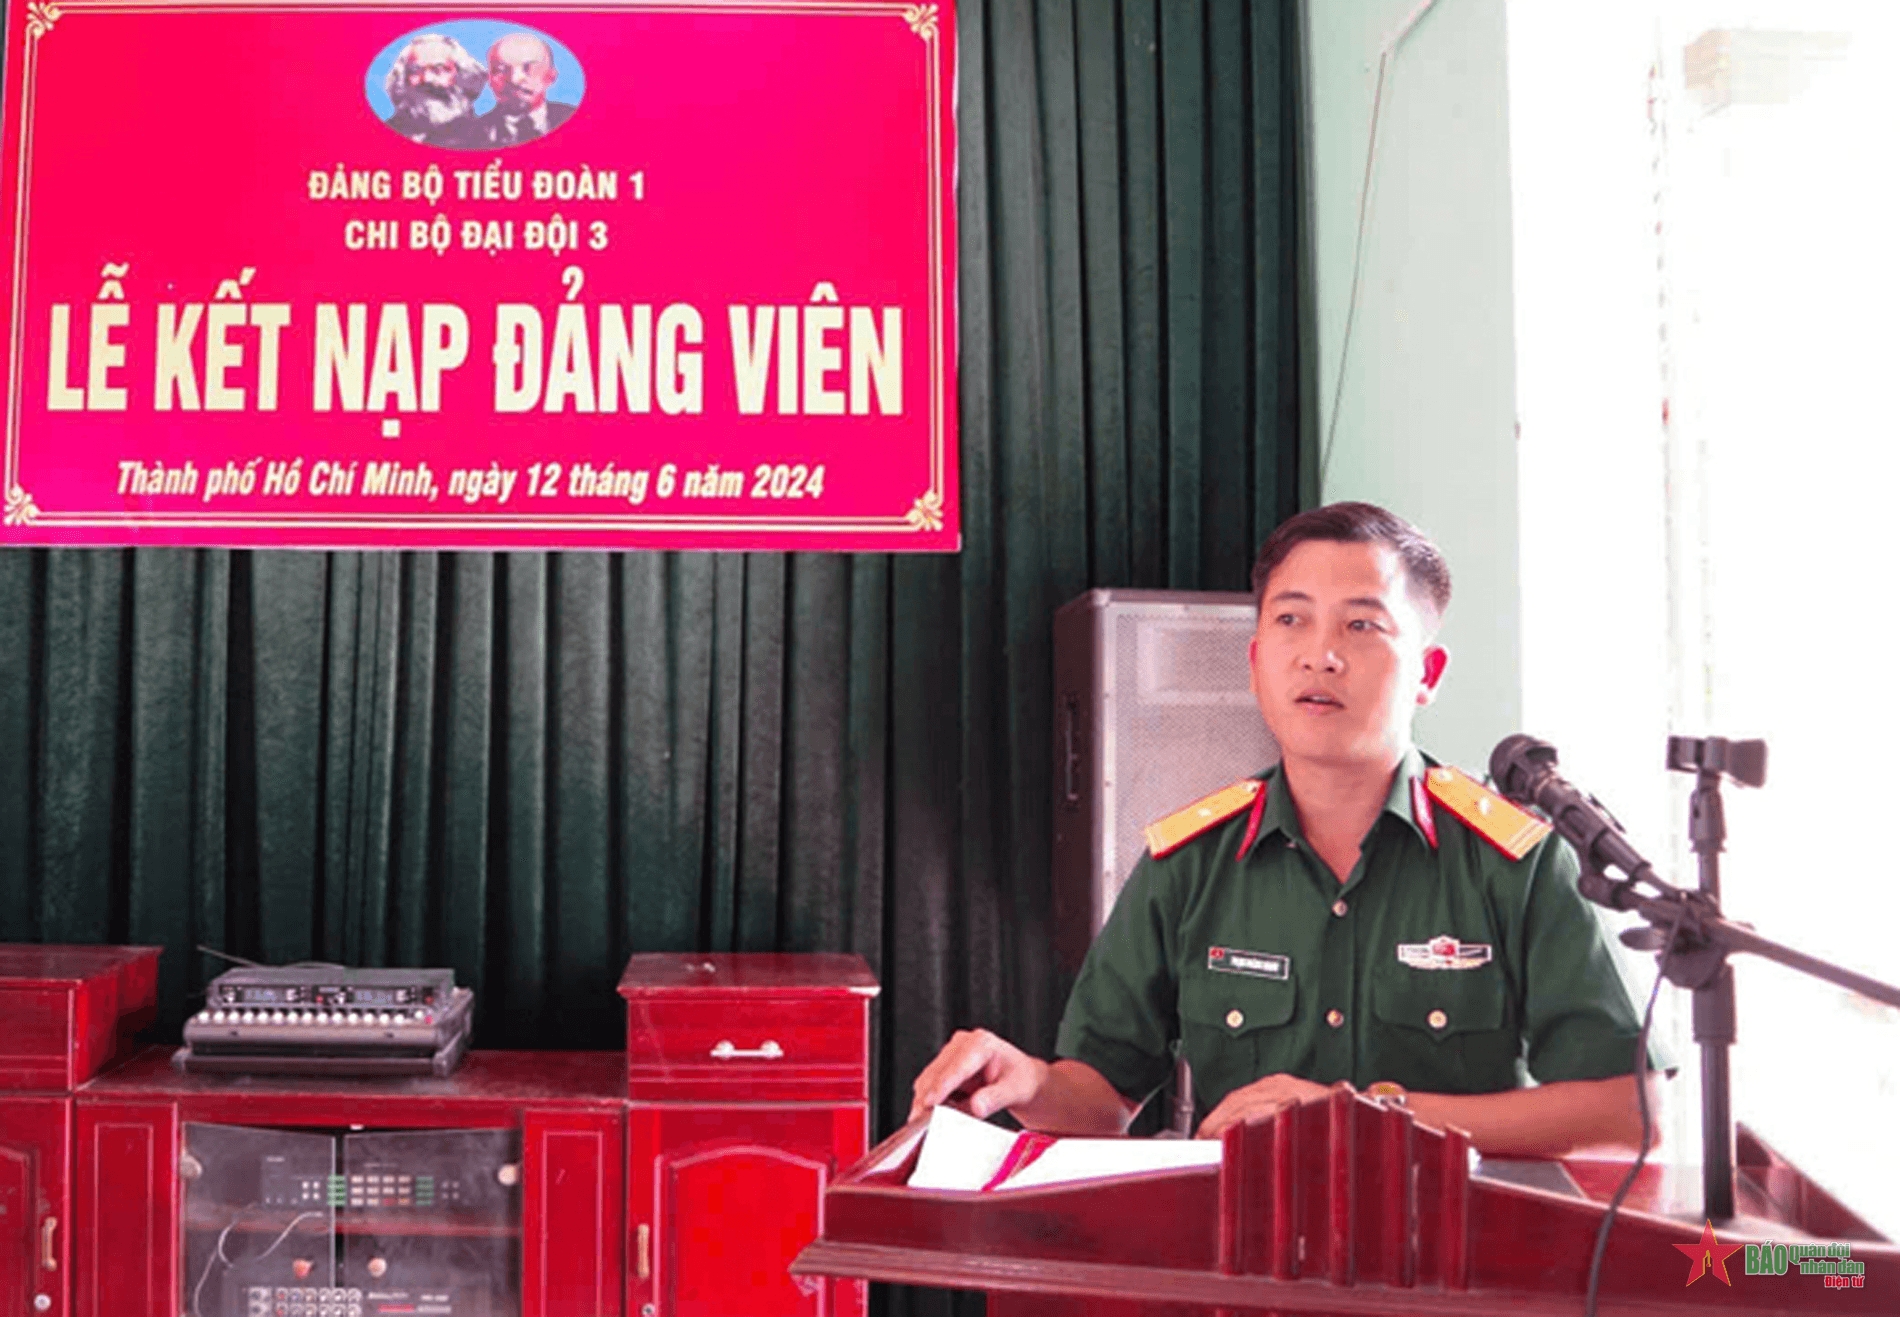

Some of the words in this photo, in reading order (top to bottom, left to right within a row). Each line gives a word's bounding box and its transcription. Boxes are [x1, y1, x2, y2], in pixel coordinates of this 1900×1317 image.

[308, 163, 391, 200] ĐẢNG
[402, 164, 444, 205] BỘ
[454, 158, 523, 200] TIỂU
[532, 164, 618, 200] ĐOÀN
[630, 172, 644, 200] 1
[345, 221, 399, 250] CHI
[410, 213, 452, 256] BỘ
[461, 221, 514, 256] ĐẠI
[524, 213, 579, 257] ĐỘI
[589, 221, 609, 250] 3
[48, 262, 130, 411] LỄ
[155, 267, 291, 411] KẾT
[313, 302, 470, 438] NẠP
[493, 266, 704, 415] ĐẢNG
[729, 282, 903, 416] VIÊN
[118, 460, 199, 495] Thành
[203, 456, 263, 502] phố
[309, 461, 358, 495] Chí
[361, 461, 439, 501] Minh,
[448, 461, 518, 503] ngày
[528, 463, 562, 497] 12
[569, 463, 650, 504] tháng
[657, 464, 677, 498] 6
[683, 465, 745, 498] năm
[751, 464, 825, 498] 2024
